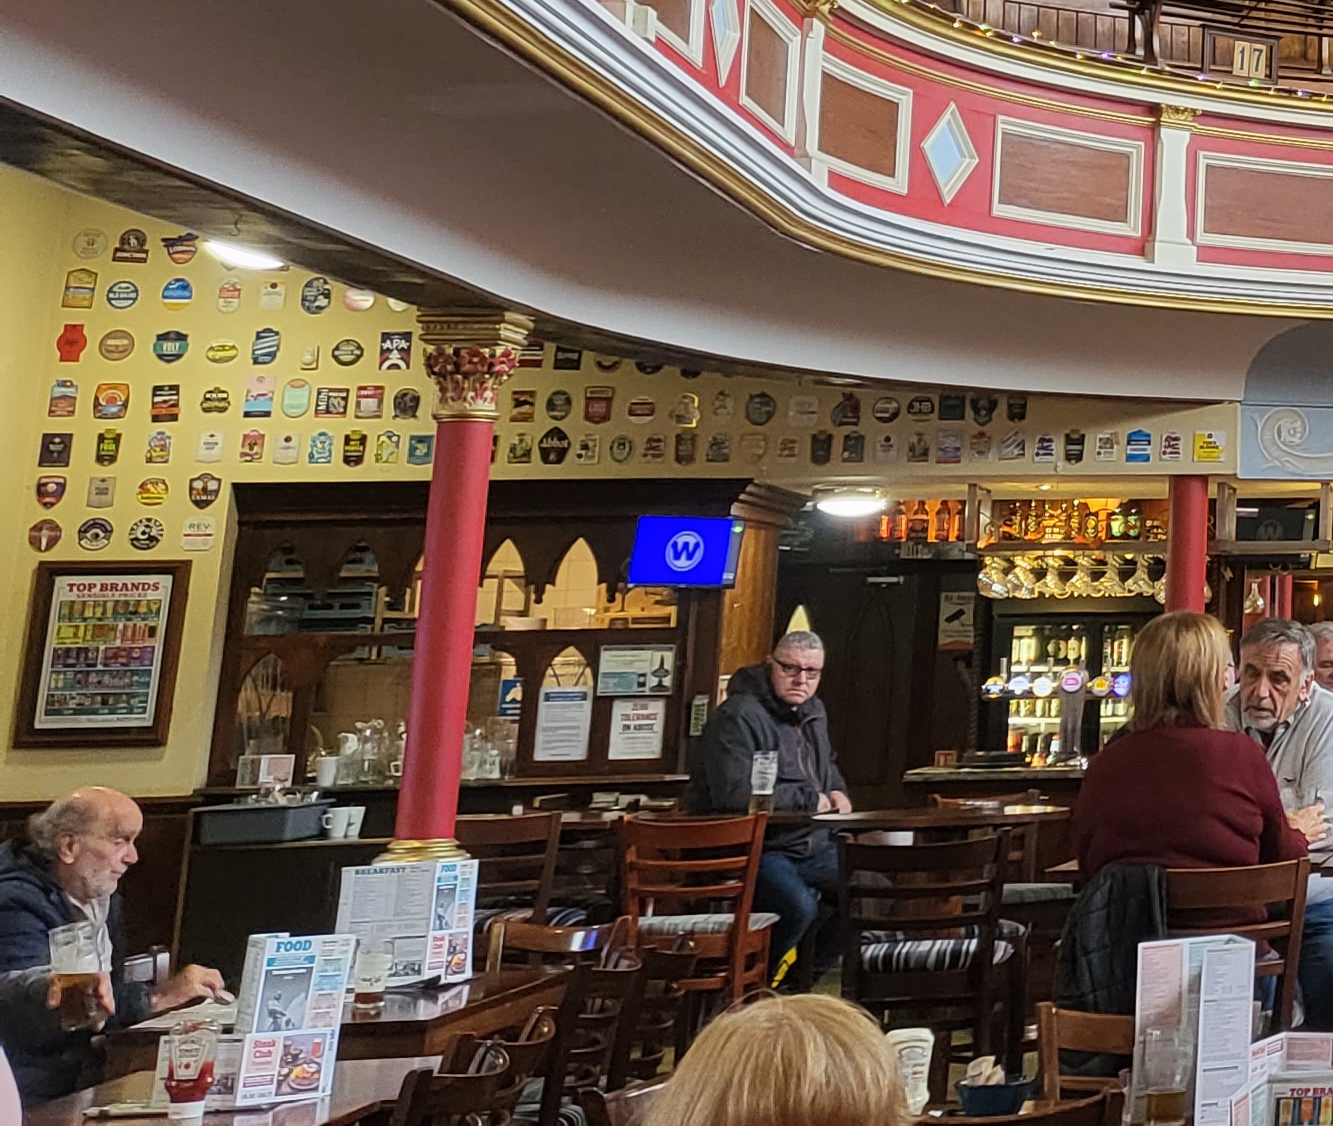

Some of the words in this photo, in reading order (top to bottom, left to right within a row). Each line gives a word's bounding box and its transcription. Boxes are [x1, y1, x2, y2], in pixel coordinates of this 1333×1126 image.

[384, 339, 407, 349] APA
[910, 401, 932, 412] JHB
[671, 541, 700, 561] W
[67, 583, 97, 592] TOP
[100, 582, 160, 592] BRANDS
[355, 867, 406, 875] BREAKFAST
[275, 940, 312, 953] FOOD
[1289, 1087, 1310, 1097] TOP
